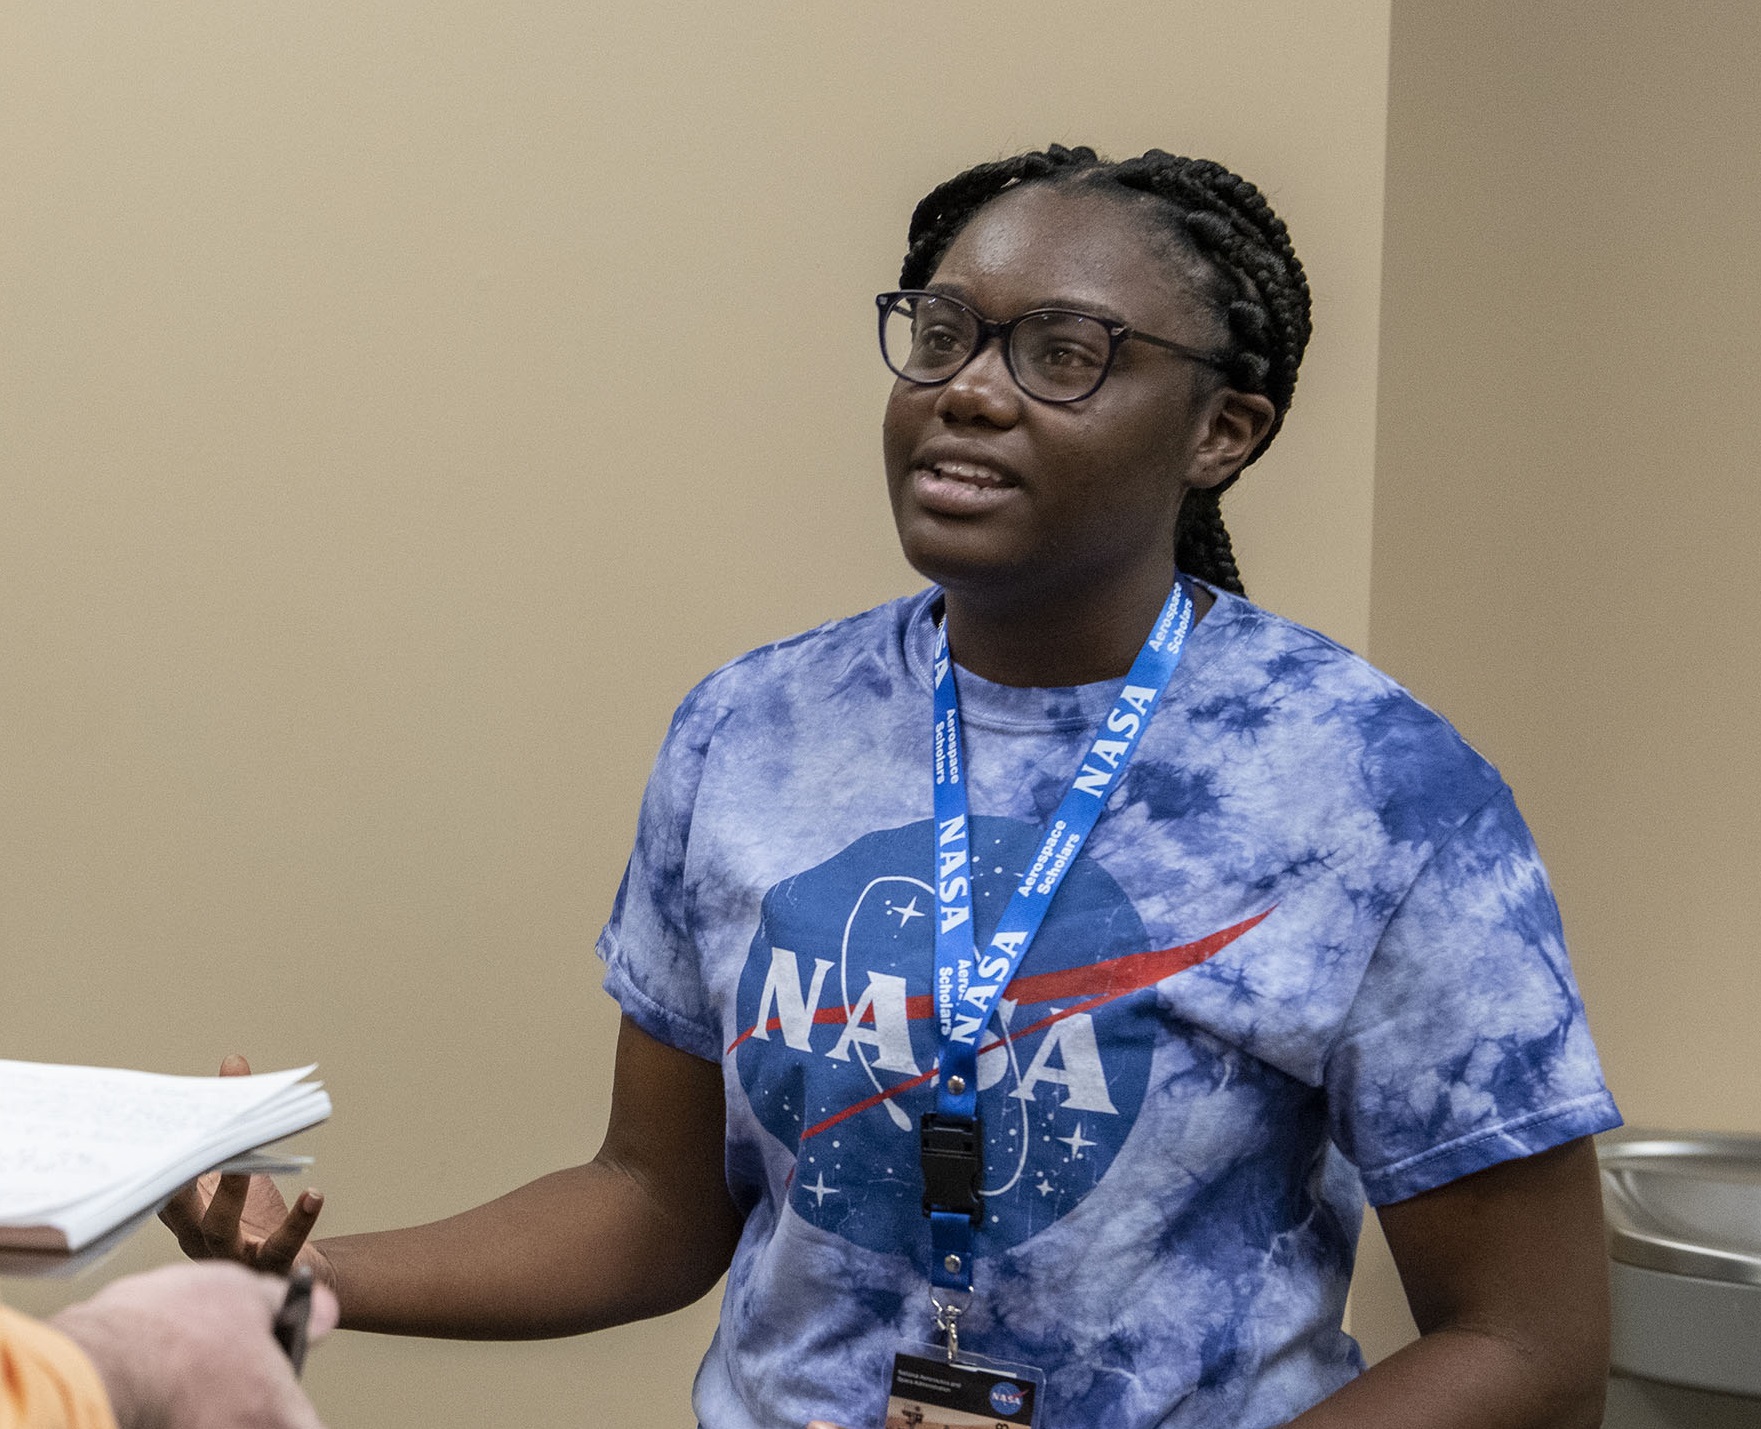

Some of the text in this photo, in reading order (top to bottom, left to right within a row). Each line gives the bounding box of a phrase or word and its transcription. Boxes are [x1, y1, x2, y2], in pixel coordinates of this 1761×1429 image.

[1148, 582, 1182, 652] Aerospace
[1167, 598, 1193, 654] Scholars
[935, 721, 946, 785] Scholars
[946, 708, 959, 784] Aerospace
[1072, 685, 1157, 798] NASA
[938, 813, 970, 935] NASA
[1017, 820, 1067, 898] Aerospace
[1036, 833, 1081, 896] Scholars
[938, 967, 953, 1036] Scholars
[949, 931, 1029, 1045] NASA
[991, 1392, 1021, 1405] NASA
